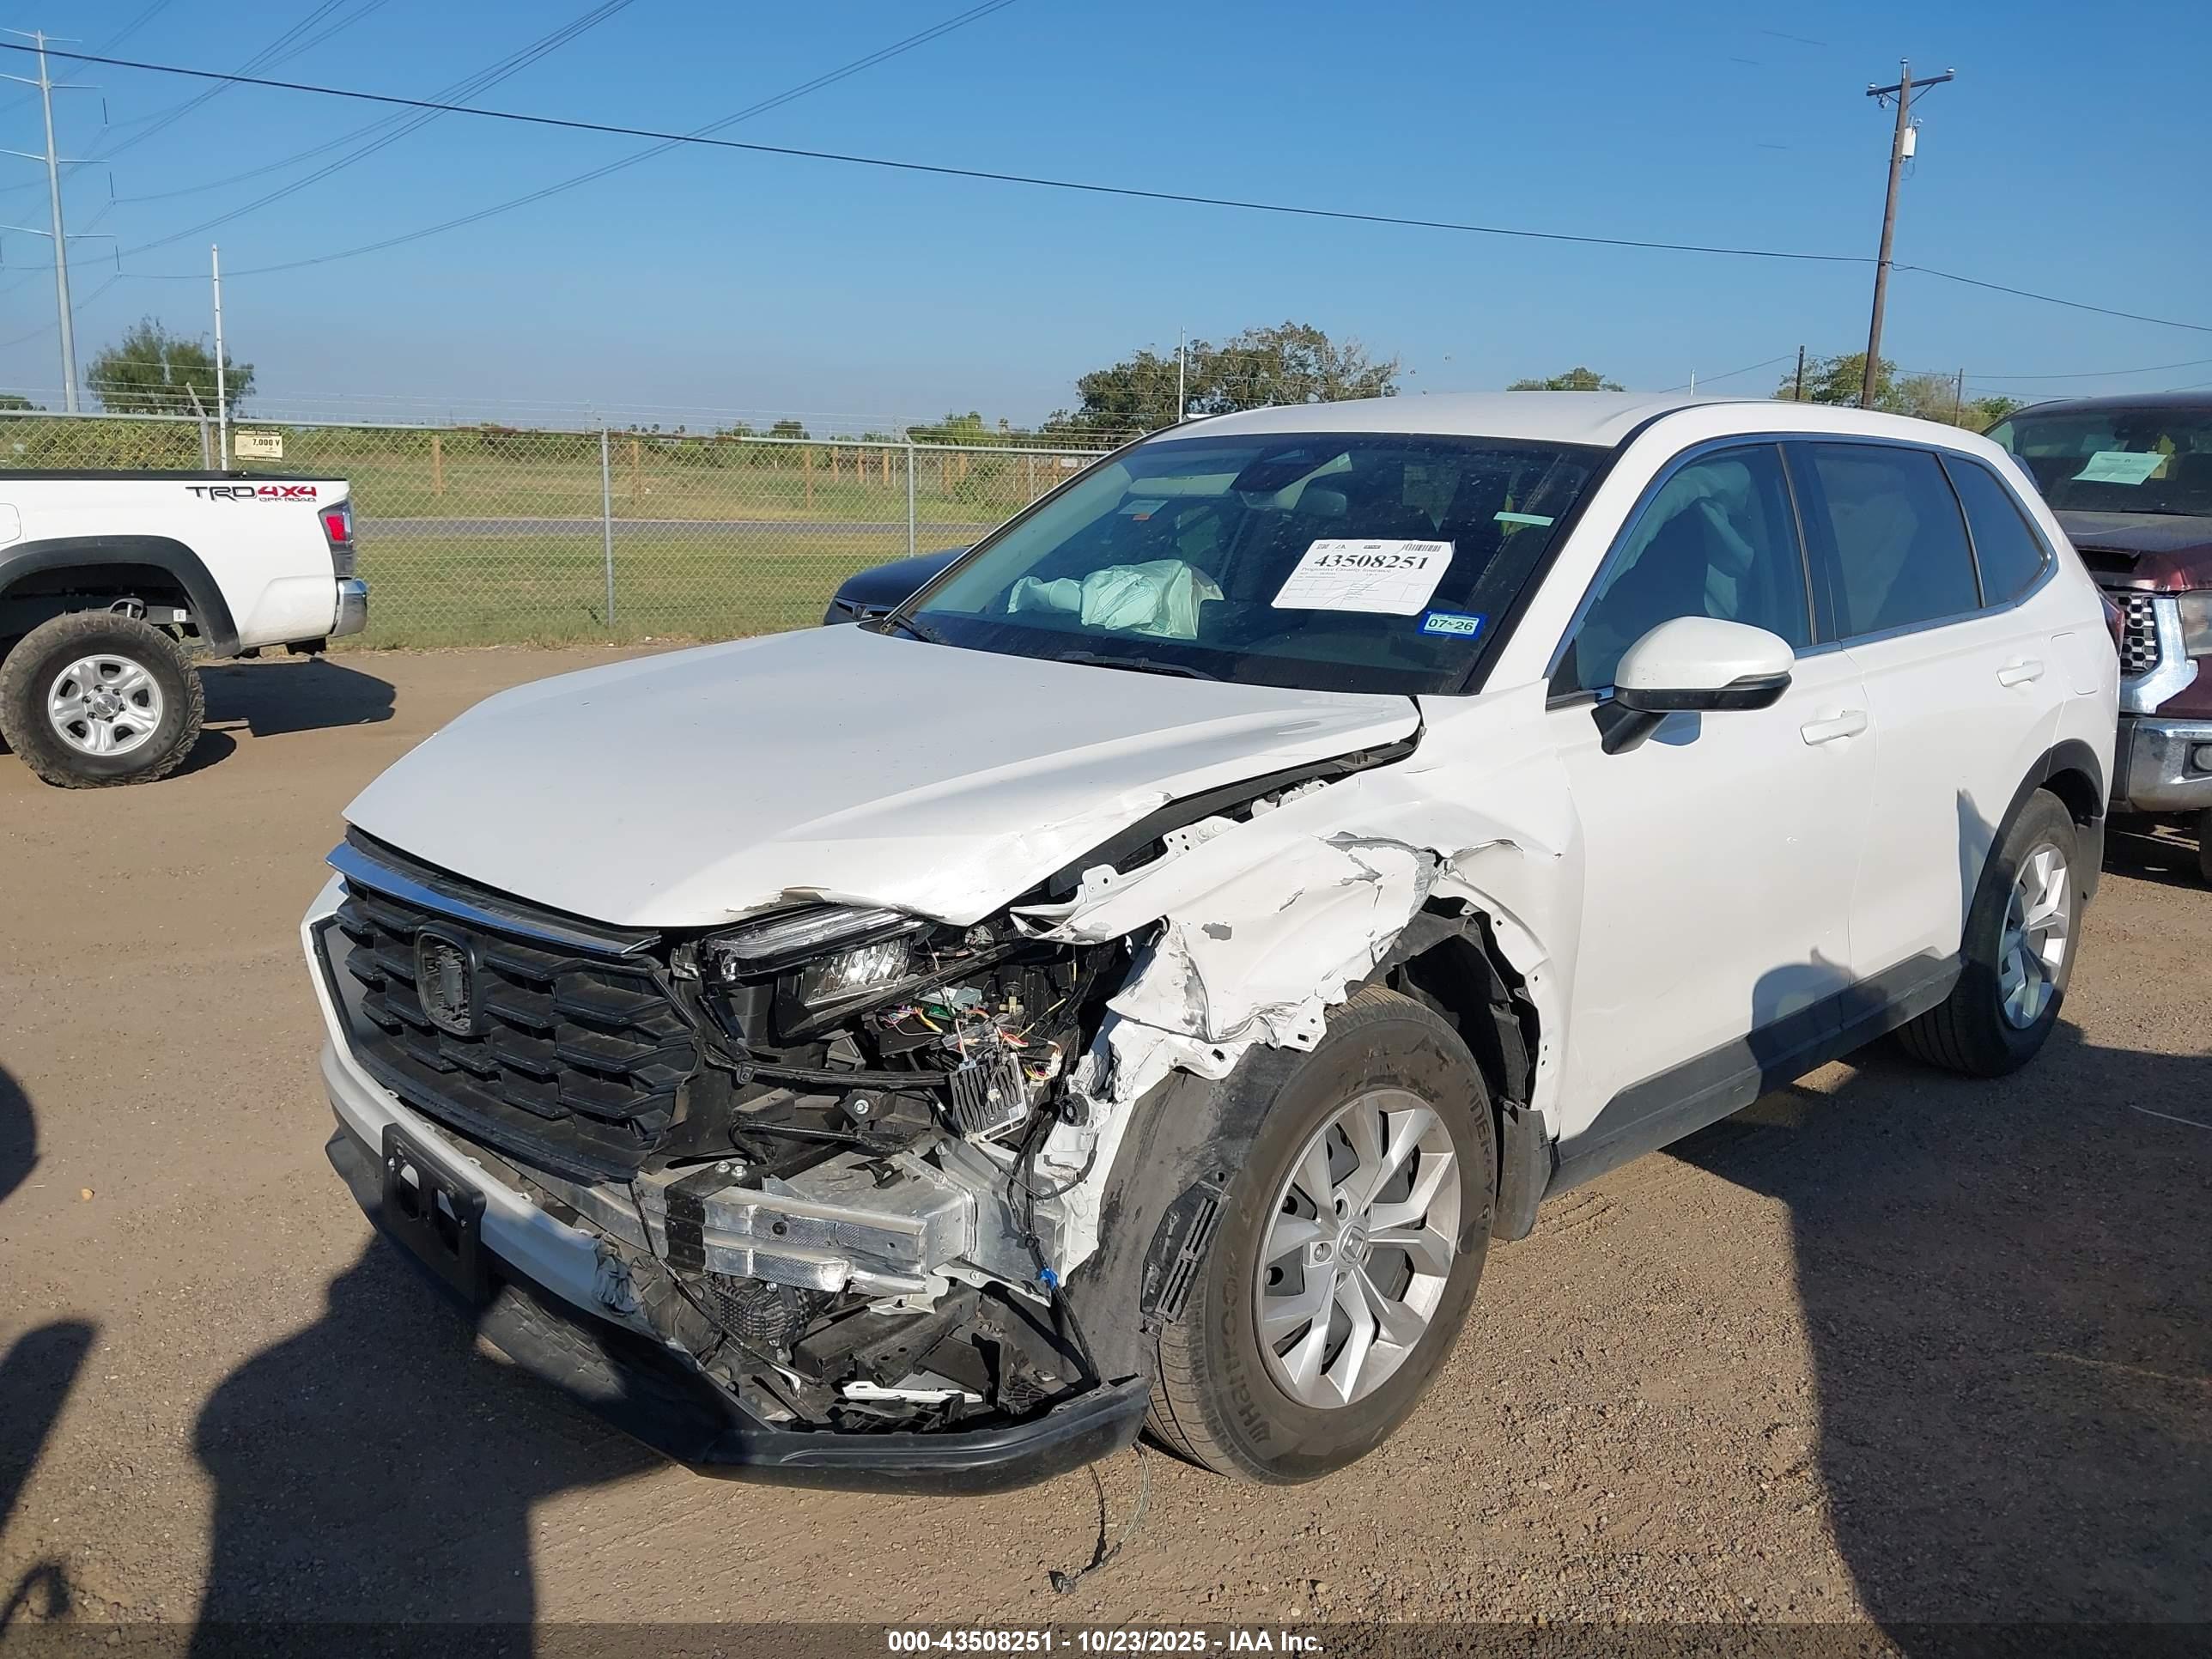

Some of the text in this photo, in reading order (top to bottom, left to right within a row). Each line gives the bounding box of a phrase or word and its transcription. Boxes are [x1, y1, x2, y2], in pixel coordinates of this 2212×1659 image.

[185, 486, 258, 502] TRD
[1314, 554, 1430, 570] 43508251
[1428, 618, 1474, 631] 07 26
